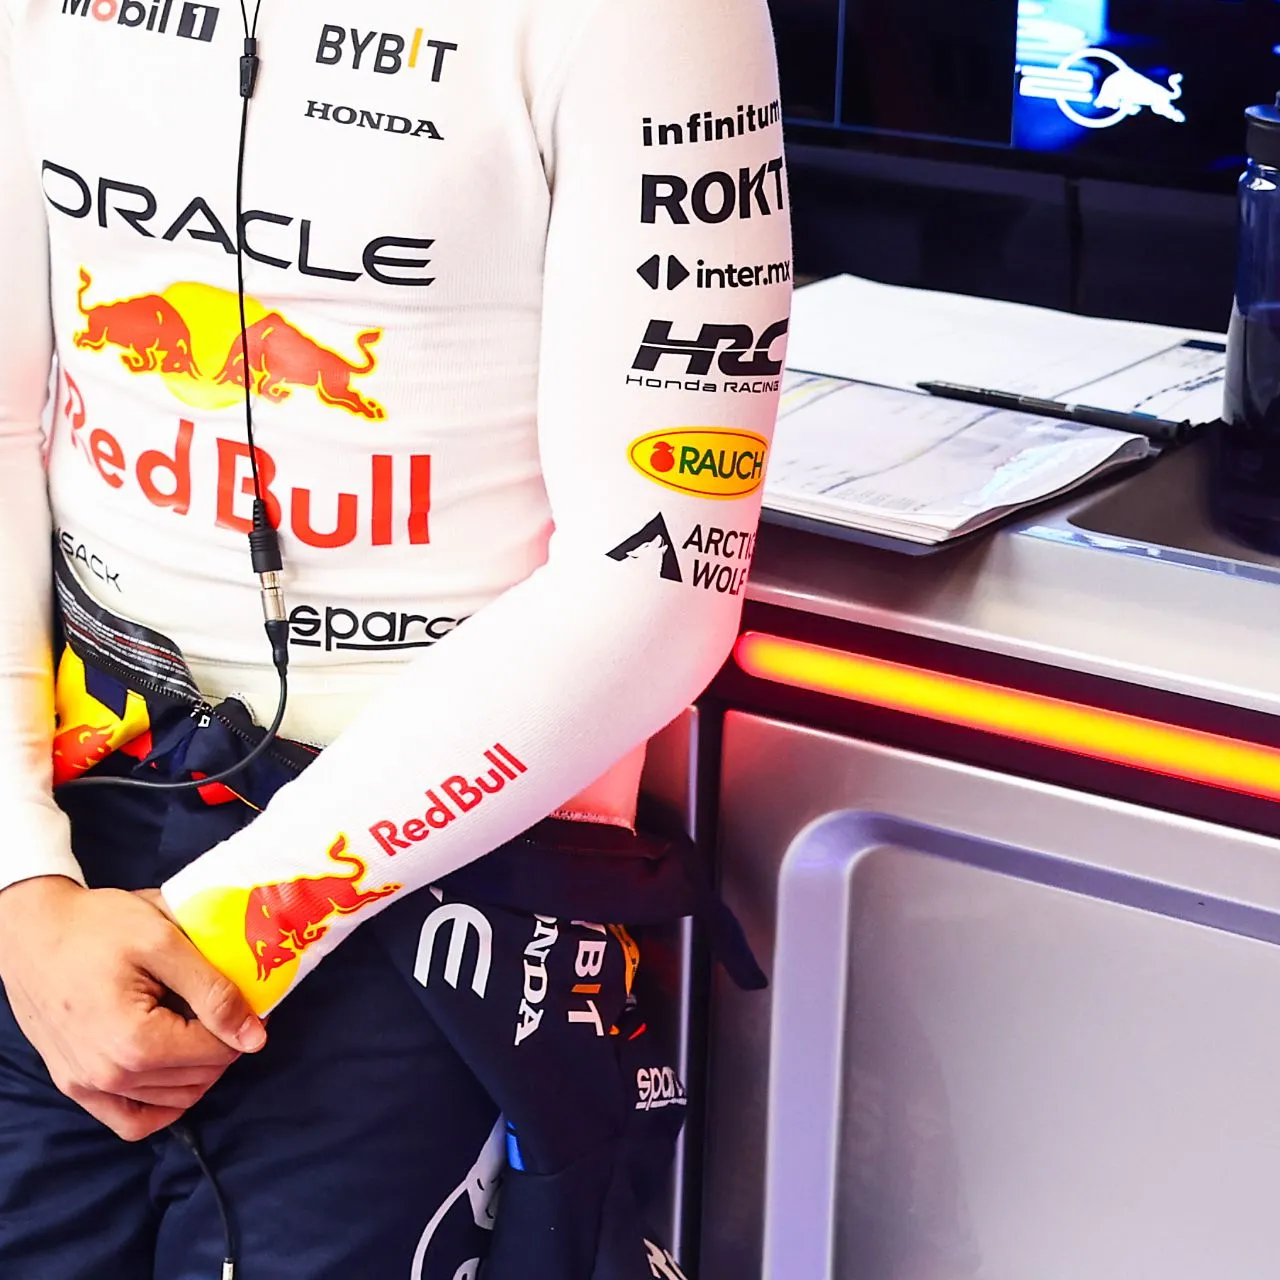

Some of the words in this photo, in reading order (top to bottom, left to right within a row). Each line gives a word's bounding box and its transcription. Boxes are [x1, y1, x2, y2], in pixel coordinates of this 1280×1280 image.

[315, 24, 458, 83] BYBIT
[305, 100, 445, 141] HONDA
[642, 98, 780, 147] infinitum
[640, 157, 784, 225] ROKT
[42, 159, 436, 287] ORACLE
[696, 258, 791, 290] inter.mx
[631, 319, 790, 376] HRC
[626, 375, 717, 393] Honda
[723, 378, 779, 394] RACING
[63, 368, 195, 516] Red
[214, 437, 432, 549] Bull
[678, 445, 764, 480] RAUCH
[368, 789, 456, 857] Red
[444, 742, 529, 813] Bull
[514, 914, 559, 1046] NDA
[567, 920, 608, 1037] BIT
